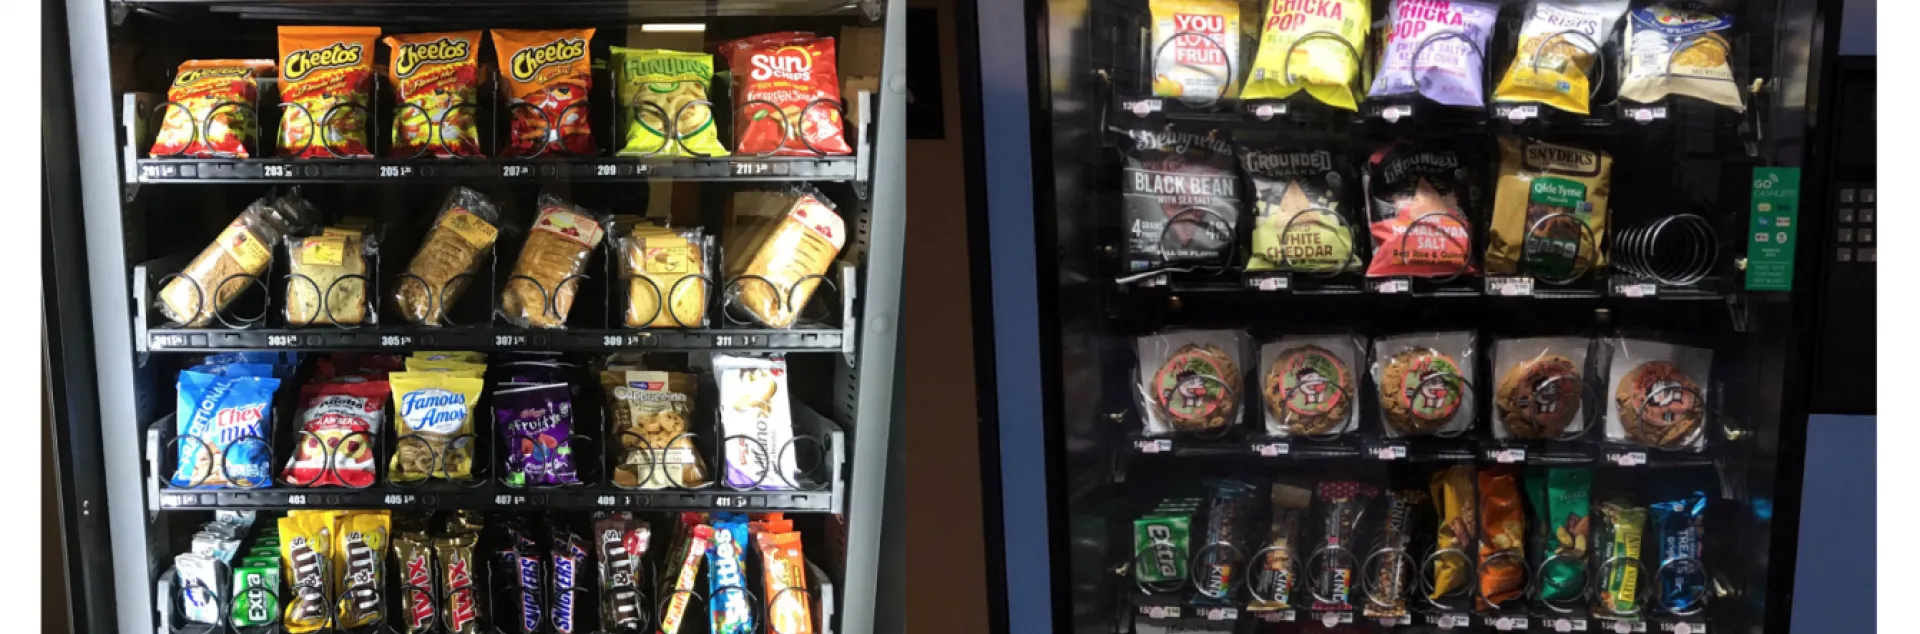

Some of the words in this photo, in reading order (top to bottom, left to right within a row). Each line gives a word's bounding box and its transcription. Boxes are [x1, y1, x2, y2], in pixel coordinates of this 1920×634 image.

[1272, 0, 1342, 20] CHICKA
[1176, 15, 1223, 33] YOU
[1265, 13, 1306, 32] POP
[1177, 33, 1224, 48] LOVE
[286, 43, 361, 76] Cheetos
[396, 38, 467, 75] Cheetos
[513, 40, 584, 78] Cheetos
[1177, 48, 1222, 62] FRUIT
[625, 56, 712, 78] FUNYUNS
[751, 54, 812, 81] Sun
[1247, 151, 1331, 172] GROUNDED
[264, 165, 283, 177] 203
[380, 165, 399, 177] 205
[503, 165, 520, 177] 207
[597, 164, 616, 176] 209
[736, 164, 751, 175] 211
[1135, 171, 1186, 194] BLACK
[1189, 177, 1234, 196] BEAN
[1754, 179, 1772, 189] GO
[1558, 185, 1582, 198] Tyme
[1157, 195, 1177, 203] WITH
[1131, 218, 1142, 237] 4
[1277, 232, 1322, 246] WHITE
[1417, 237, 1447, 249] SALT
[1266, 245, 1333, 259] CHEDDAR
[268, 335, 287, 346] 303
[381, 335, 399, 346] 305
[495, 335, 512, 346] 307
[603, 335, 622, 346] 309
[716, 335, 732, 346] 311
[399, 391, 466, 417] Famous
[217, 404, 266, 427] Chex
[413, 407, 468, 431] Amos
[288, 494, 306, 505] 403
[384, 494, 402, 505] 405
[495, 494, 511, 505] 407
[597, 495, 615, 506] 409
[716, 496, 731, 507] 411
[1391, 500, 1405, 532] KIND
[1208, 565, 1223, 598] KIND
[1274, 568, 1289, 602] KIND
[1333, 569, 1346, 601] KIND
[406, 555, 434, 628] TWIX
[448, 558, 477, 632] TWIX
